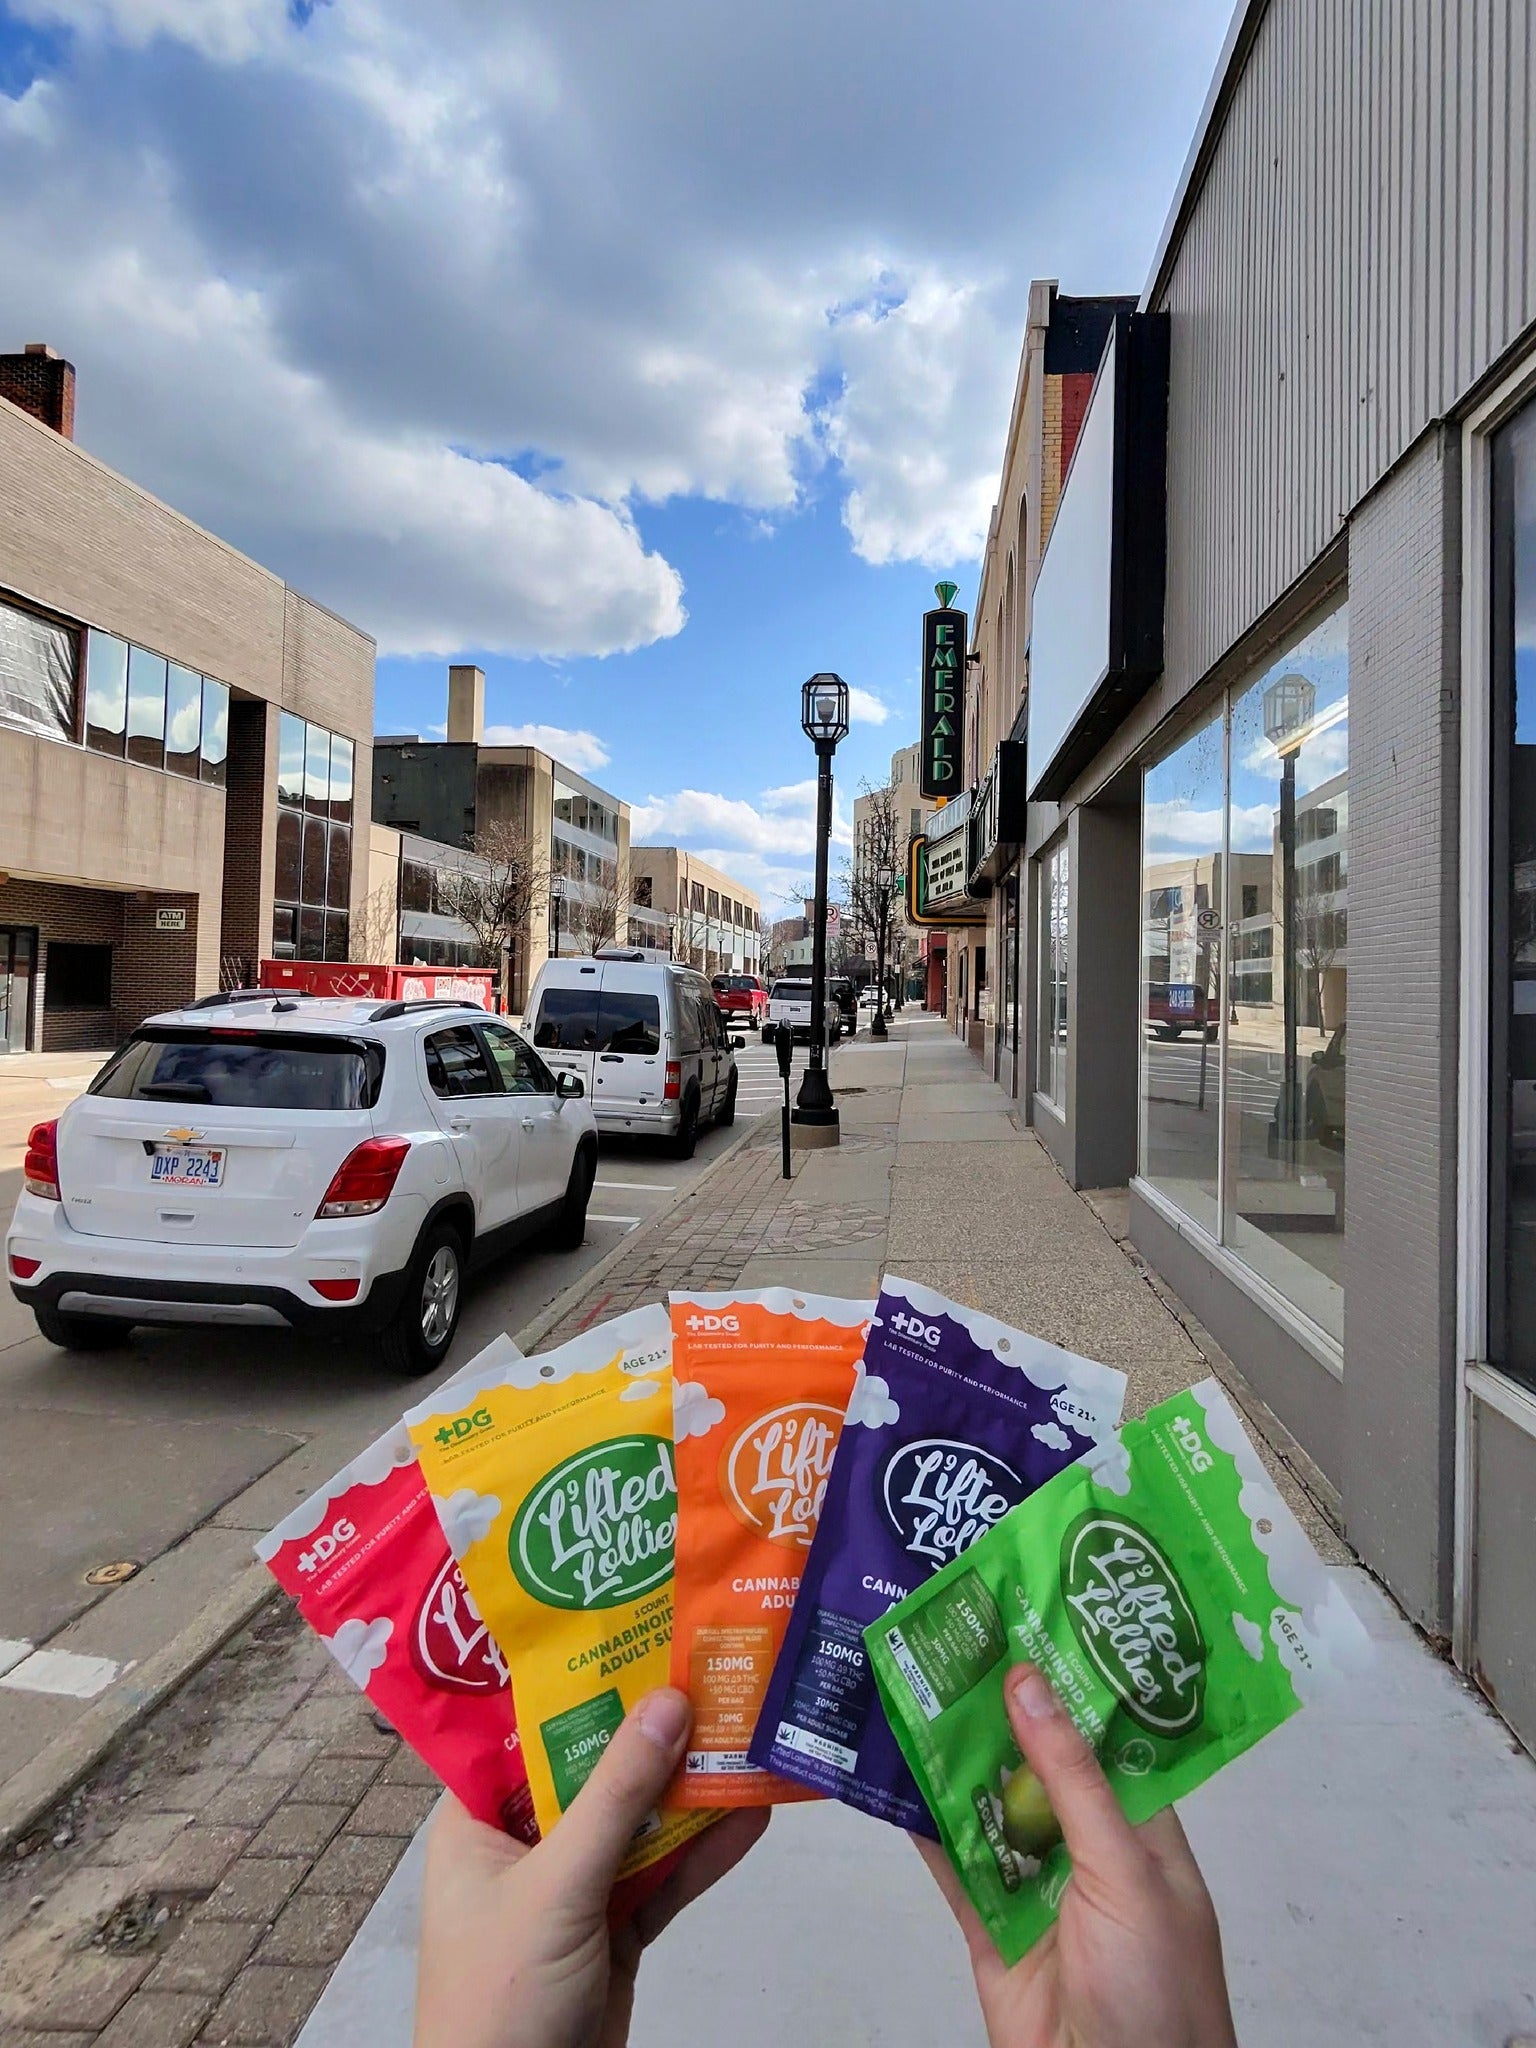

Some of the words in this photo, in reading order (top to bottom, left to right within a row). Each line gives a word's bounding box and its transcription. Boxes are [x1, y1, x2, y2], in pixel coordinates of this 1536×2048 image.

[931, 624, 958, 781] EMERALD
[160, 911, 182, 920] ATM
[154, 1155, 179, 1175] DXP
[164, 1175, 205, 1186] MORAN
[623, 1356, 647, 1371] AGE
[648, 1348, 668, 1363] 21+
[883, 1340, 898, 1350] LAB
[898, 1346, 924, 1362] TESTED
[924, 1358, 938, 1369] FOR
[938, 1365, 963, 1381] PURITY
[963, 1376, 978, 1388] AND
[979, 1383, 1028, 1410] PERFORMANCE
[1050, 1397, 1075, 1415] AGE
[1077, 1408, 1097, 1424] 21+
[491, 1432, 507, 1443] FOR
[507, 1418, 535, 1434] PURITY
[535, 1411, 552, 1422] AND
[901, 1450, 1019, 1526] Lifte
[538, 1442, 678, 1573] Lifted
[1200, 1518, 1214, 1536] AND
[315, 1578, 333, 1596] LAB
[332, 1552, 362, 1580] TESTED
[361, 1539, 376, 1555] FOR
[375, 1514, 402, 1541] PURITY
[402, 1499, 417, 1516] AND
[732, 1576, 800, 1593] CANNAB
[862, 1575, 908, 1600] CANN
[640, 1593, 670, 1616] COUNT
[761, 1594, 796, 1610] ADU
[956, 1598, 989, 1648] 150MG
[1088, 1537, 1201, 1696] Lifted
[818, 1639, 864, 1667] 150MG
[931, 1637, 950, 1665] 30MG
[1015, 1585, 1085, 1703] CANNABINOID
[1066, 1579, 1162, 1704] Lollies
[1274, 1615, 1299, 1644] AGE
[1293, 1644, 1313, 1670] 21+
[600, 1638, 651, 1678] ADULT
[706, 1655, 754, 1672] 150MG
[811, 1655, 824, 1667] 100
[824, 1659, 837, 1670] MG
[848, 1666, 866, 1682] THC
[717, 1674, 730, 1684] MG
[743, 1673, 760, 1684] THC
[819, 1680, 831, 1690] PER
[831, 1685, 844, 1696] BAG
[827, 1671, 840, 1683] MG
[840, 1676, 857, 1690] CBD
[911, 1664, 932, 1698] WARNING
[1070, 1658, 1095, 1692] COUNT
[723, 1685, 736, 1694] MG
[737, 1685, 755, 1694] CBD
[718, 1713, 744, 1723] 30MG
[815, 1696, 840, 1713] 30MG
[796, 1713, 808, 1723] PER
[808, 1716, 826, 1731] ADULT
[825, 1723, 849, 1740] SUCKER
[564, 1729, 611, 1763] 150MG
[813, 1737, 843, 1754] WARNING
[769, 1755, 782, 1769] This
[782, 1762, 808, 1779] product
[808, 1771, 836, 1790] contains
[819, 1763, 837, 1777] 2018
[977, 1796, 999, 1843] SOUR
